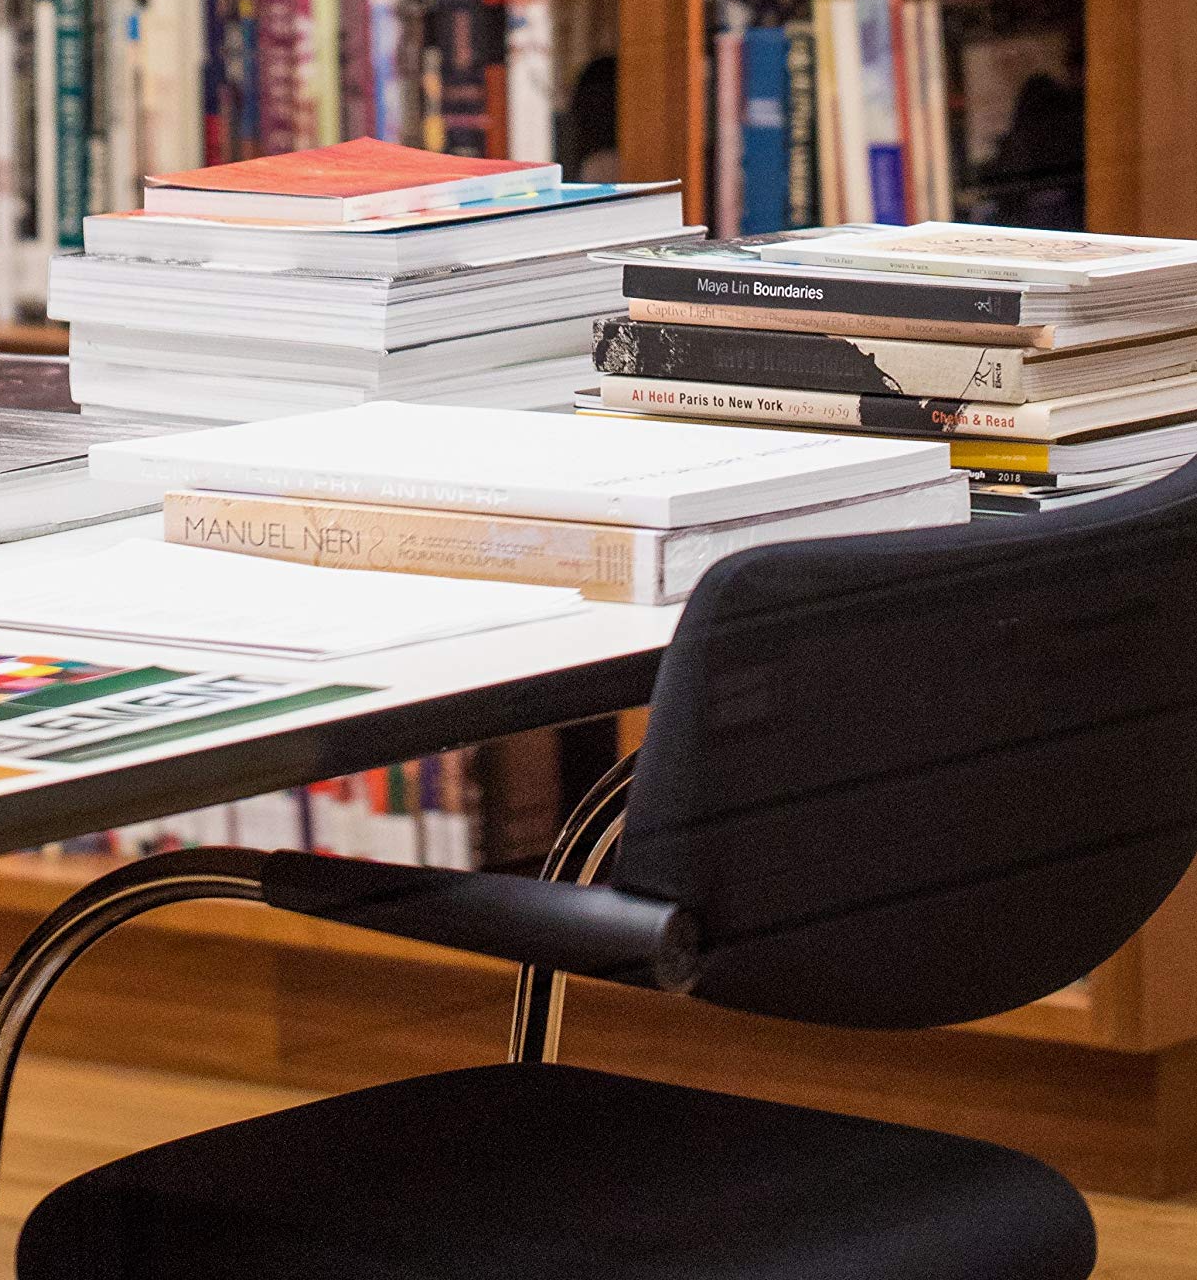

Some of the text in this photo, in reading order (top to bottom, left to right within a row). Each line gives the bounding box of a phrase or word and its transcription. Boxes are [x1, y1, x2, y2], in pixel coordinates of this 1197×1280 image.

[697, 278, 824, 299] Maya Lin Boundaries
[646, 303, 686, 319] Captive
[689, 306, 716, 320] Light
[632, 389, 850, 419] Al Held Paris to New York 1952 1959
[972, 413, 981, 426] &
[985, 414, 1015, 428] Read
[968, 470, 1021, 483] ugh 2018
[185, 516, 294, 549] MANUEL
[303, 526, 361, 555] NERI
